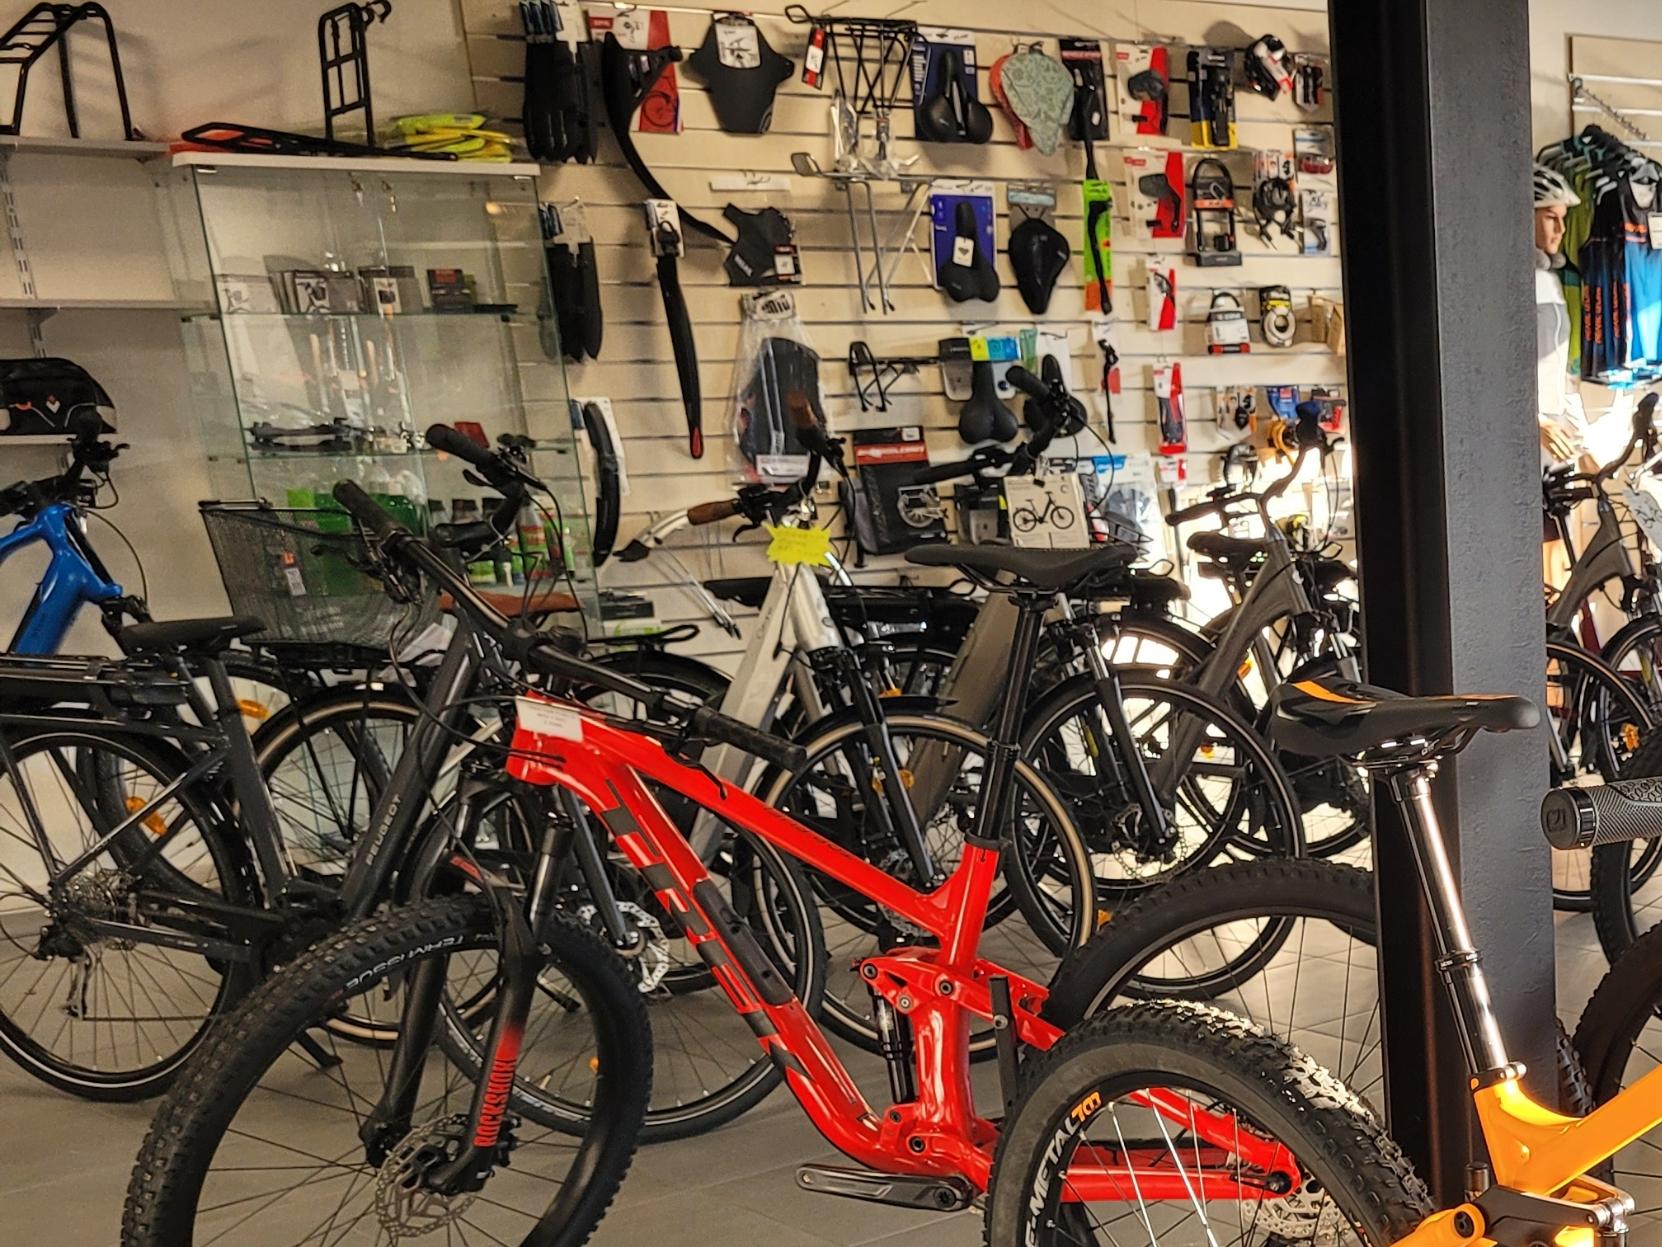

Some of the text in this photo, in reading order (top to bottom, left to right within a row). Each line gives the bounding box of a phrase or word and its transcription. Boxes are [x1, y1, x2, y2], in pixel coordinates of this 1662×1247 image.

[365, 794, 404, 867] PEUGEOT
[604, 776, 812, 1082] TREK
[473, 1058, 517, 1147] ROCKSHOX
